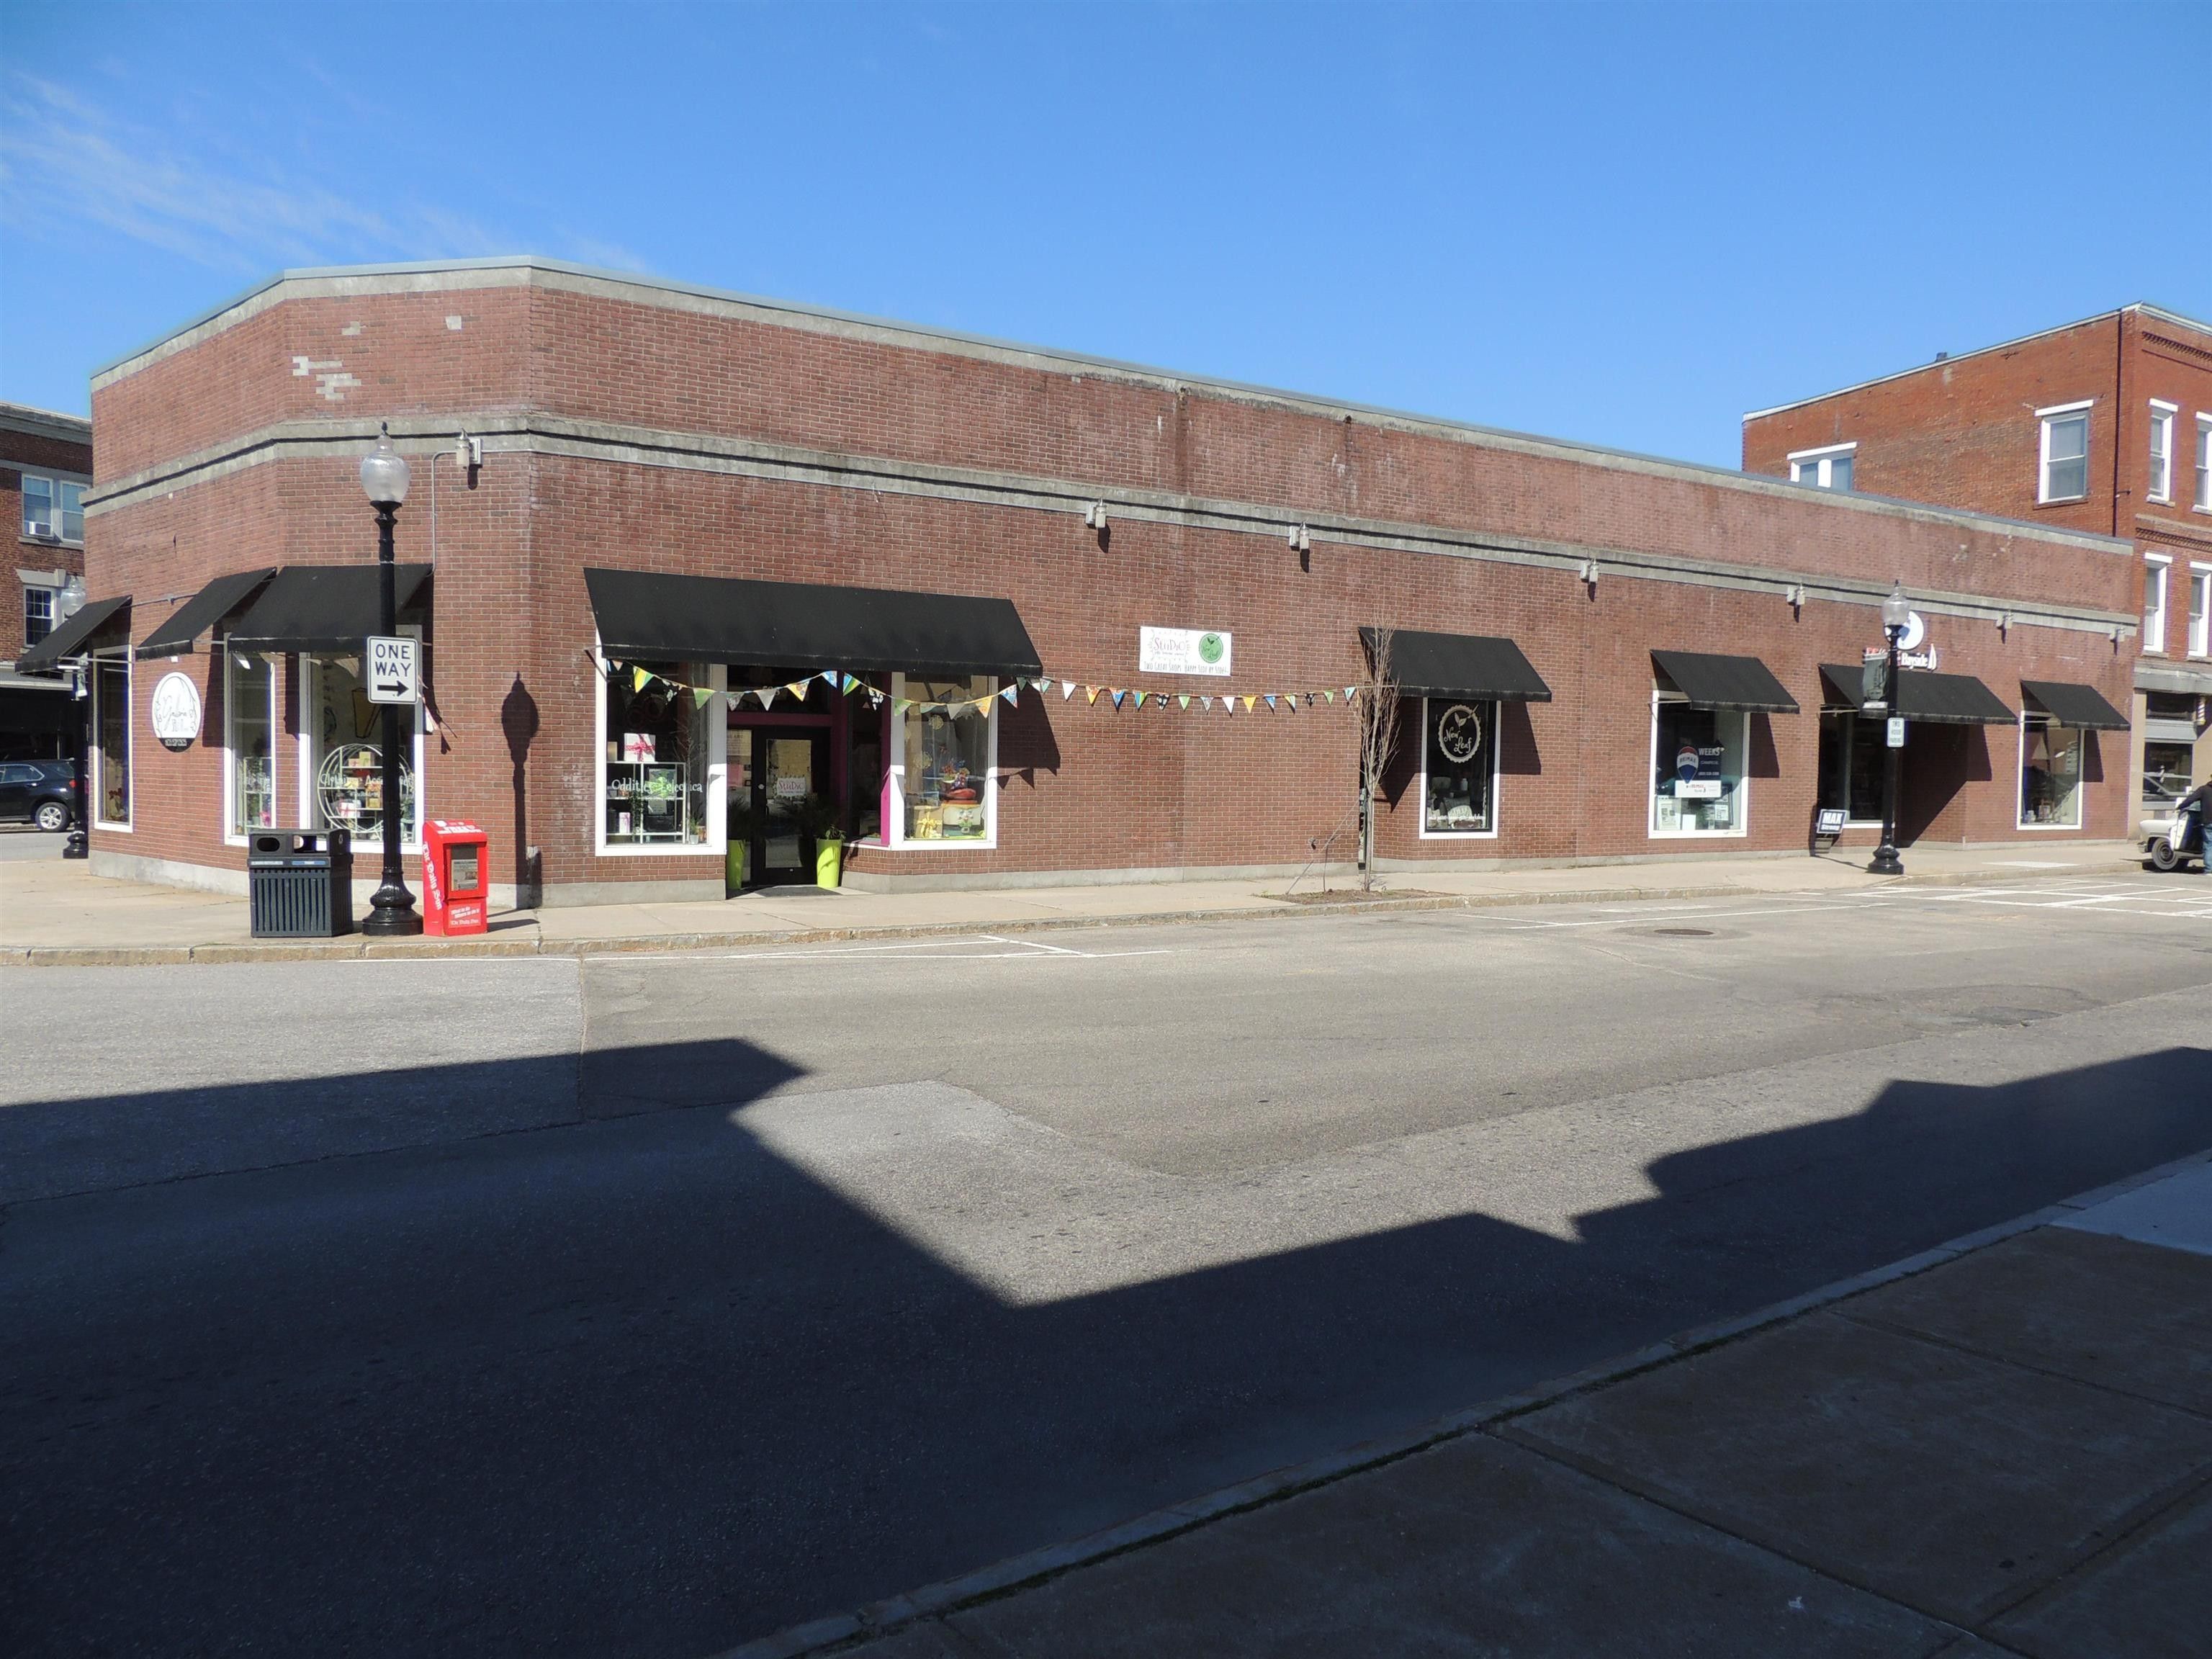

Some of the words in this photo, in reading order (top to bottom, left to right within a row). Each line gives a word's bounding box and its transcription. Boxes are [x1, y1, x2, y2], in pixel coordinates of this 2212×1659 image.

[375, 643, 410, 660] ONE
[375, 661, 411, 677] WAY
[1901, 652, 1929, 670] Bayside
[1443, 727, 1460, 742] New
[1453, 737, 1473, 754] Leaf
[1822, 812, 1843, 824] MAX
